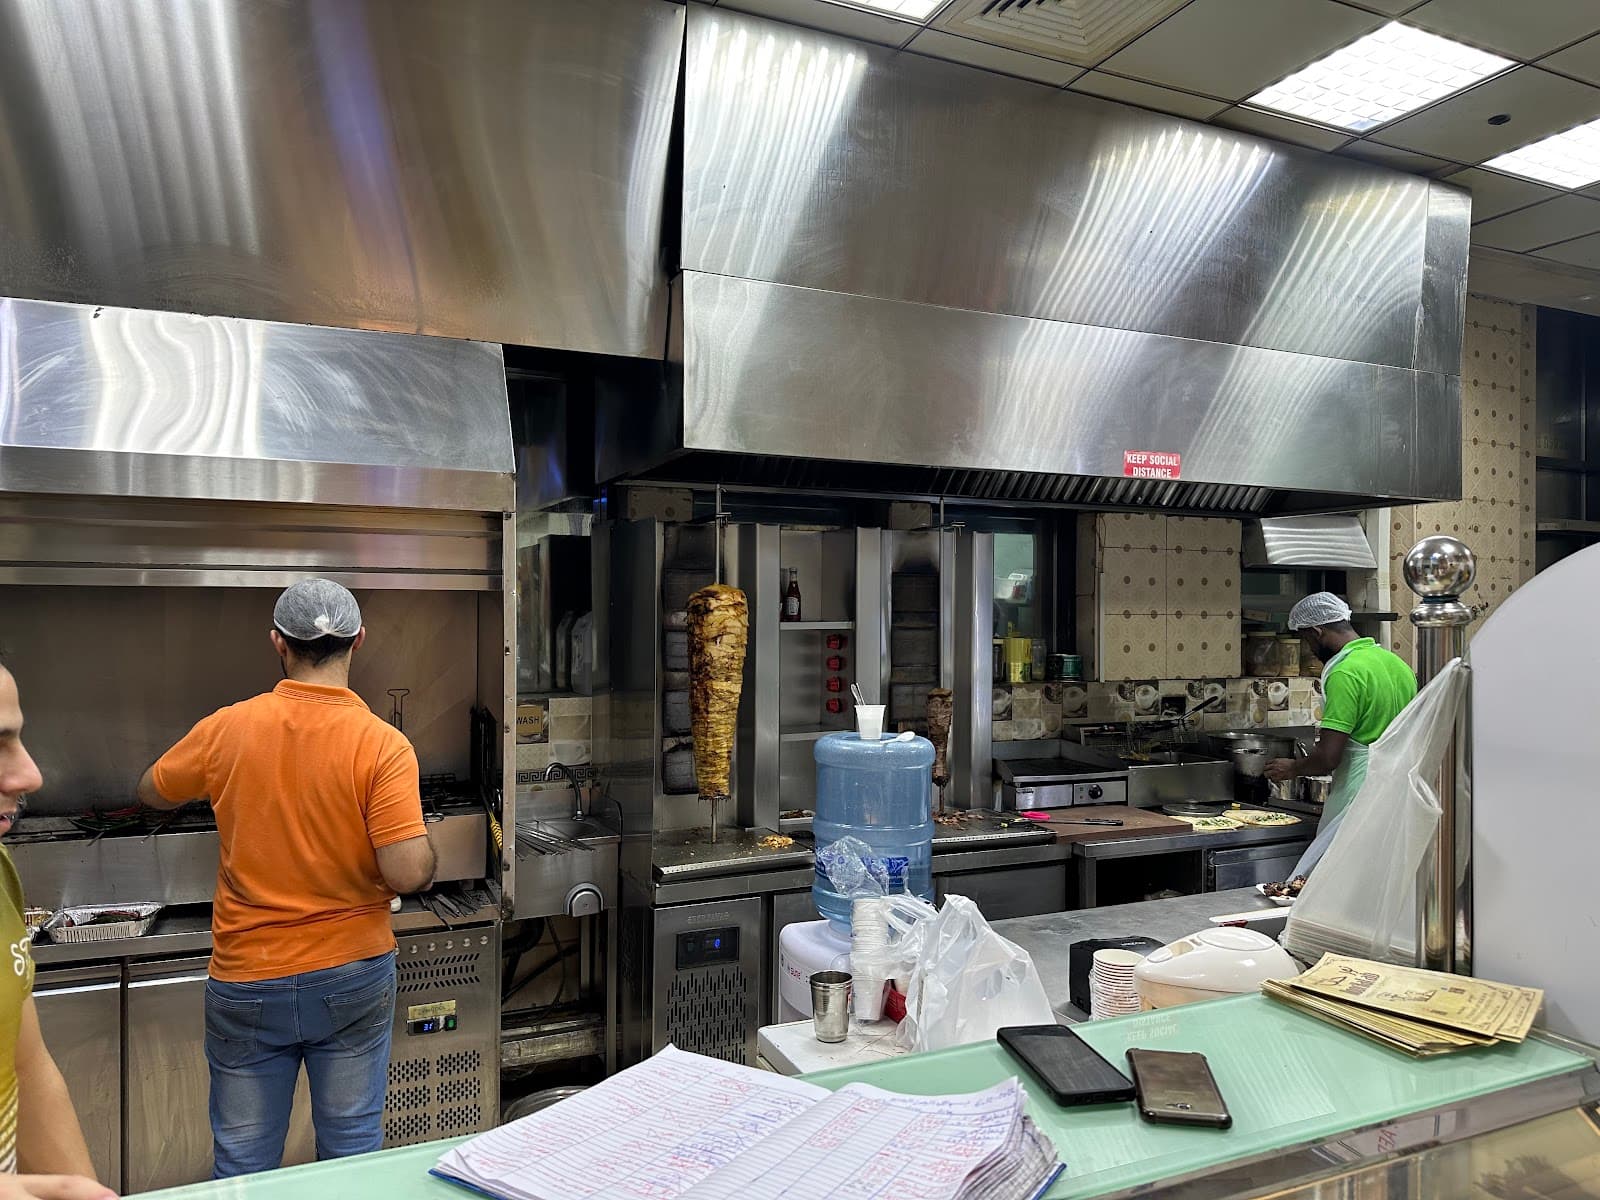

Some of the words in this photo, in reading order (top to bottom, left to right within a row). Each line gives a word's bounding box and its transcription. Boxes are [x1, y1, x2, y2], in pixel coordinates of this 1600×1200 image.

[1127, 454, 1147, 464] KEEP
[1149, 455, 1178, 466] SOCIAL
[1132, 467, 1172, 478] DISTANCE
